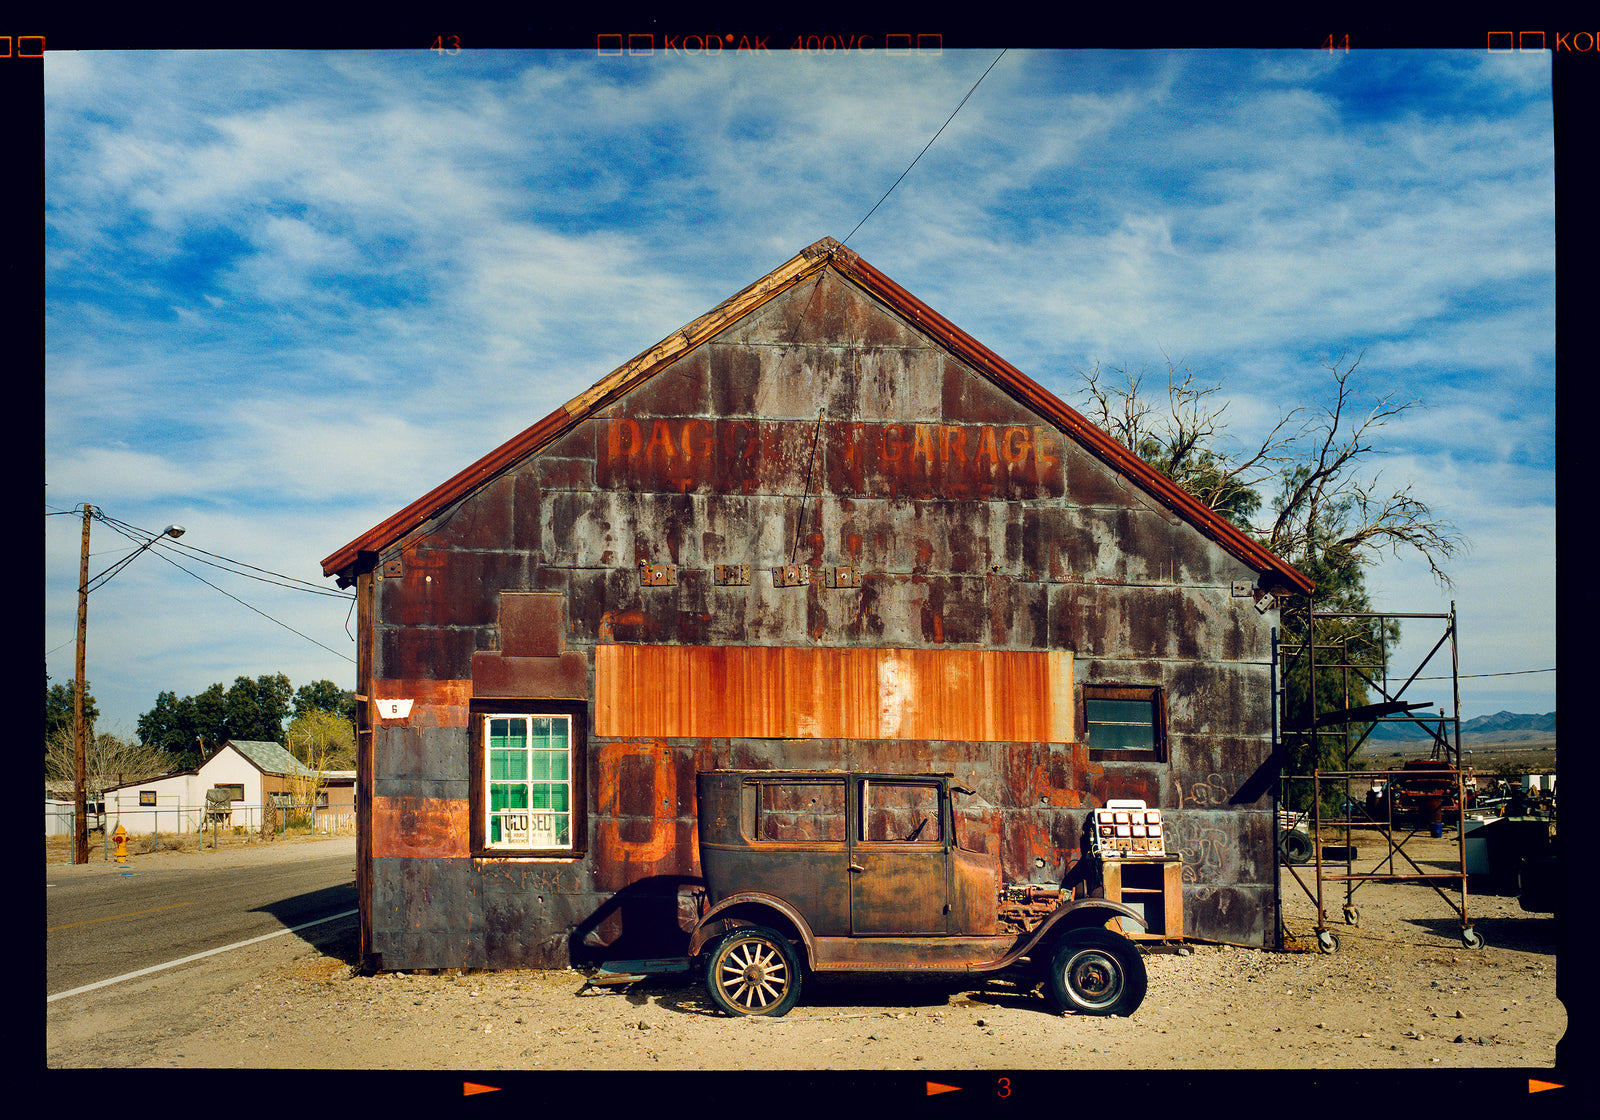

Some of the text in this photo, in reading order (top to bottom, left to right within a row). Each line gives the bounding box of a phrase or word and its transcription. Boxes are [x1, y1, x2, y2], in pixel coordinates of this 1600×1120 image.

[430, 35, 461, 56] 43
[790, 35, 875, 56] 400VC
[1321, 33, 1352, 54] 44
[1556, 31, 1600, 52] KO
[876, 423, 1059, 464] GARAGE
[391, 704, 398, 714] 6
[505, 814, 551, 831] CLOSED
[997, 1077, 1011, 1098] 3
